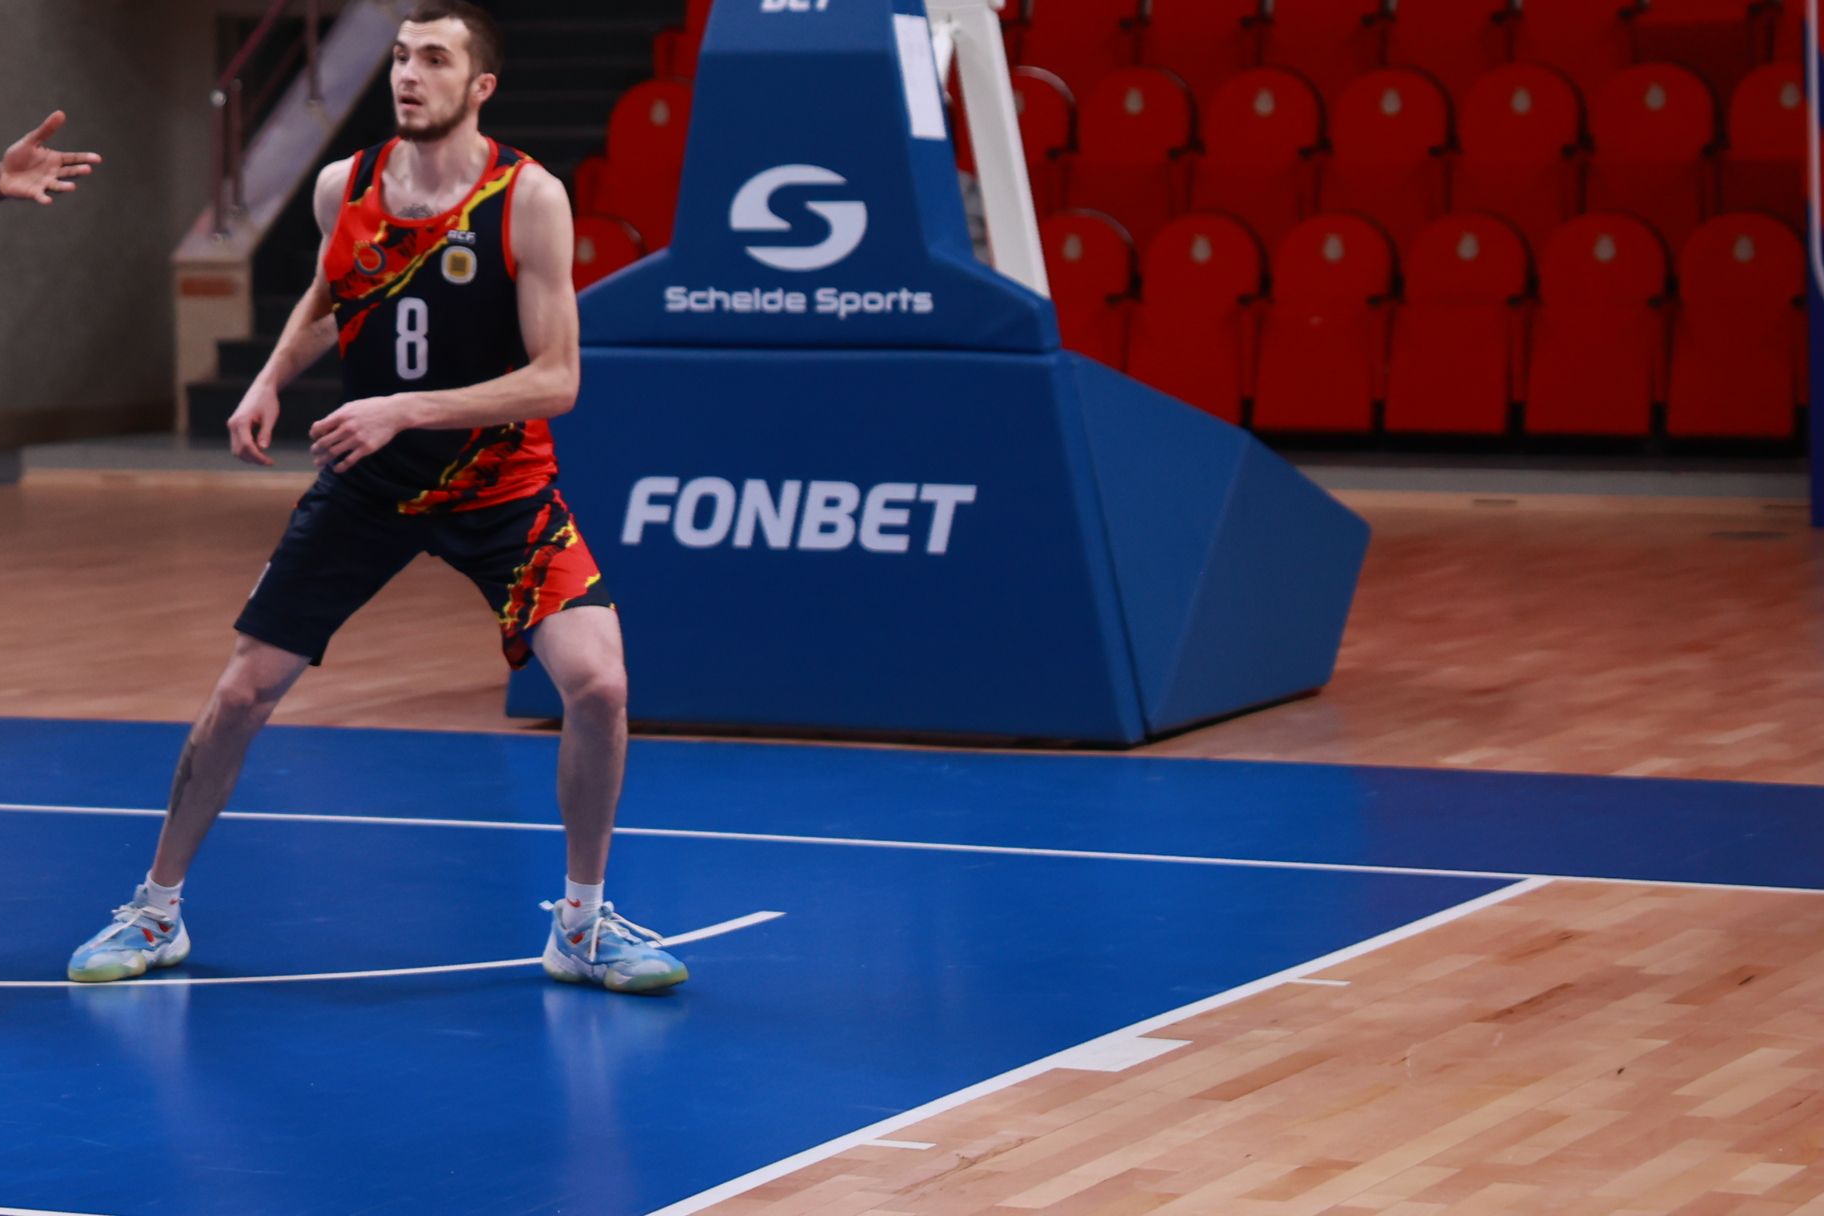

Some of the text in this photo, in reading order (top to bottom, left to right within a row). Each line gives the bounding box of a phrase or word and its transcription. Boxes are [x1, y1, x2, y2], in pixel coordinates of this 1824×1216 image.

[394, 296, 429, 381] 8
[664, 285, 934, 319] Schelde Sports
[621, 476, 977, 555] FONBET
